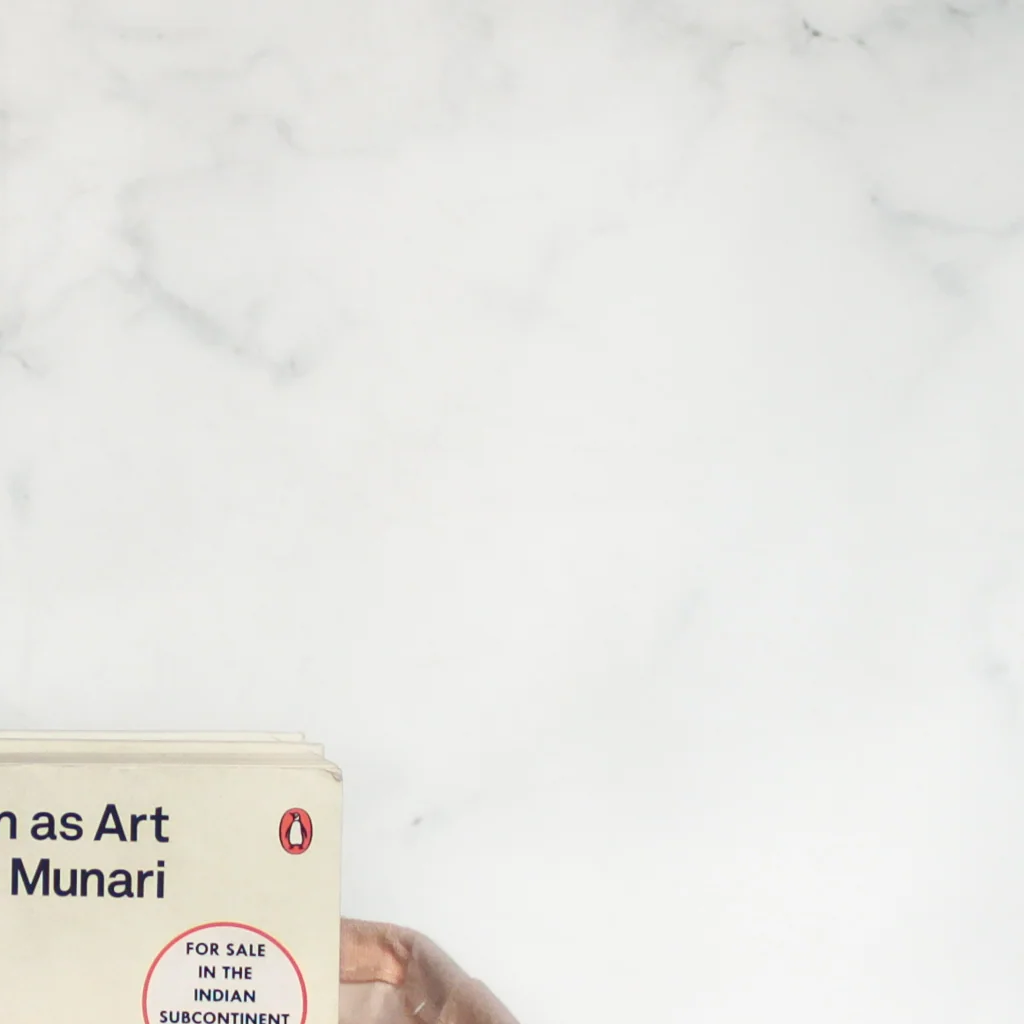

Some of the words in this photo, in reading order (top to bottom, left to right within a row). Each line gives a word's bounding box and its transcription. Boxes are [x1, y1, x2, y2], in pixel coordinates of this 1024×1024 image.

[31, 811, 84, 842] as
[94, 803, 170, 843] Art
[11, 857, 166, 899] Munari
[186, 942, 219, 956] FOR
[226, 943, 265, 957] SALE
[198, 965, 216, 979] IN
[222, 966, 253, 980] THE
[194, 988, 256, 1003] INDIAN
